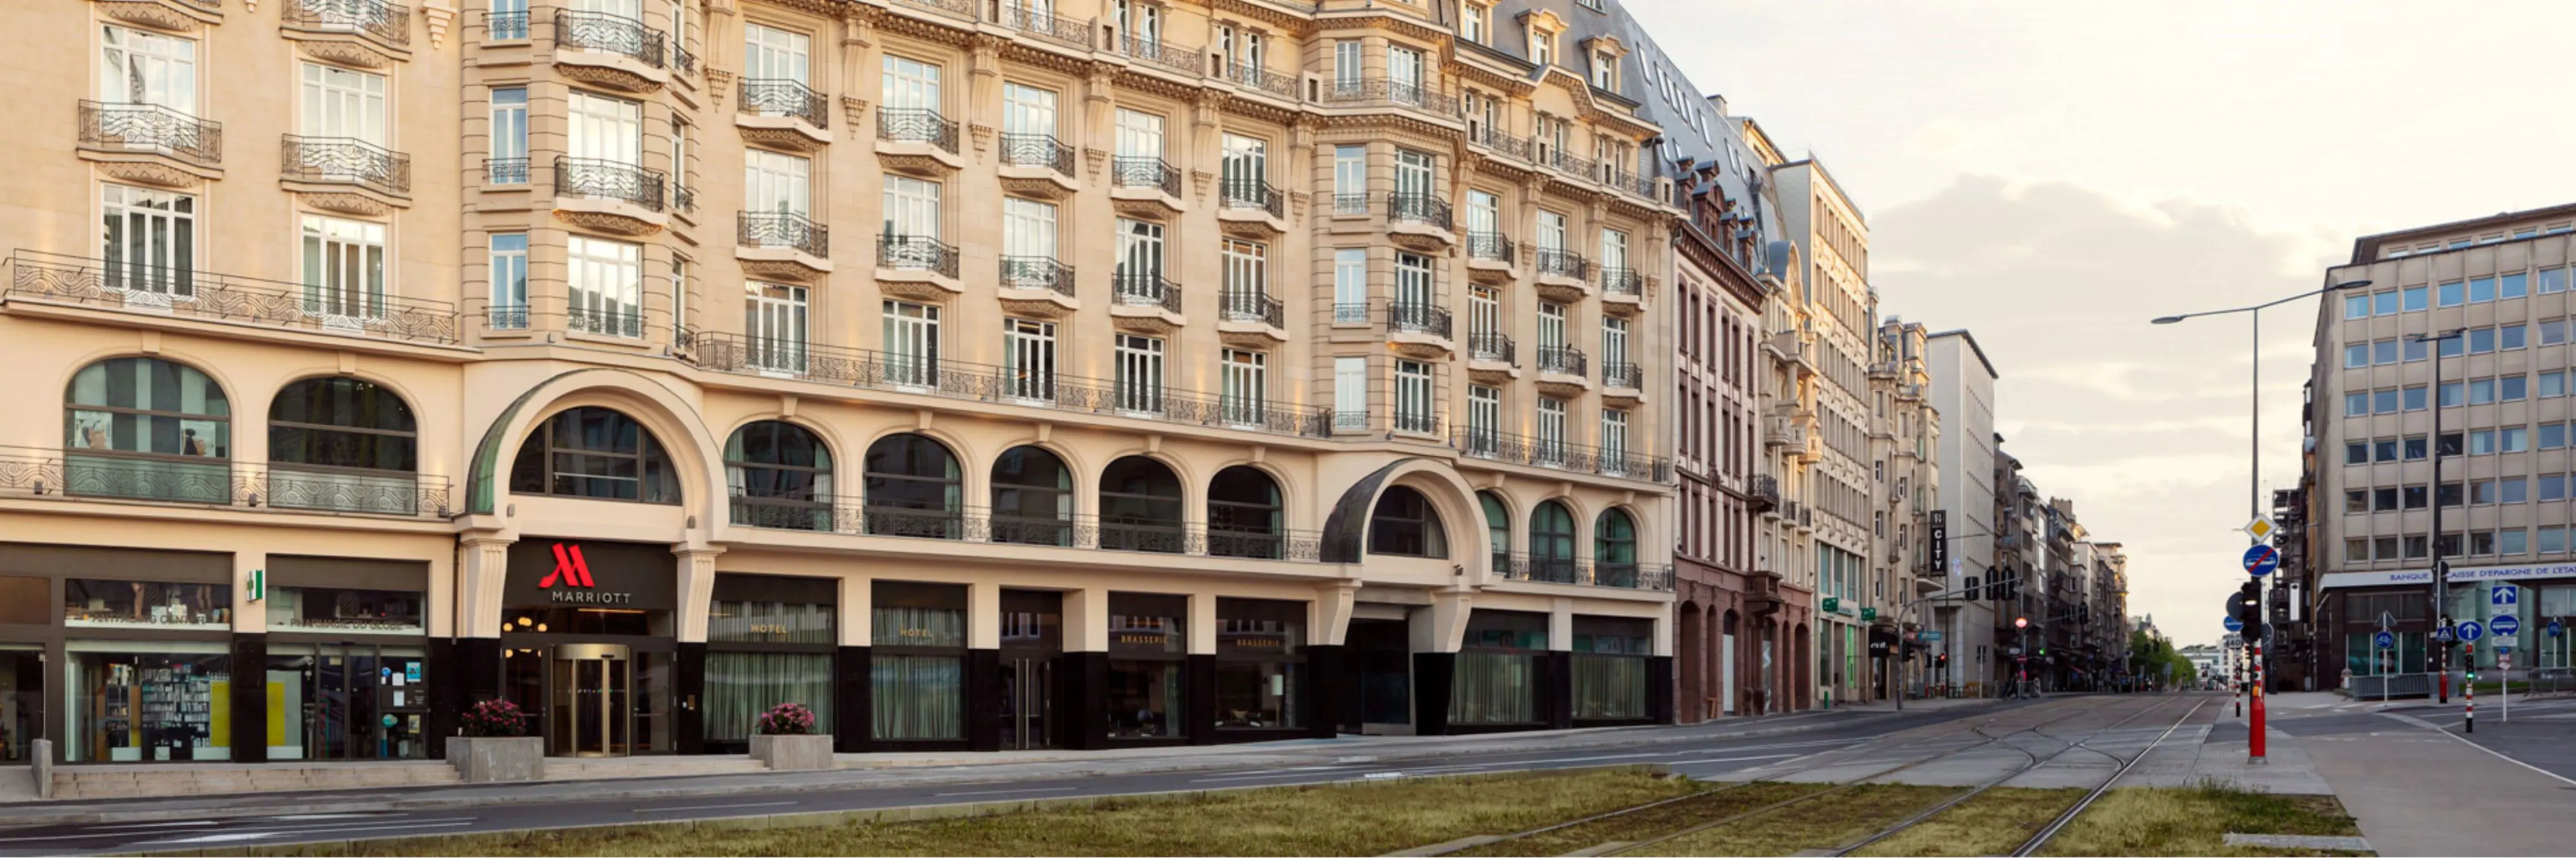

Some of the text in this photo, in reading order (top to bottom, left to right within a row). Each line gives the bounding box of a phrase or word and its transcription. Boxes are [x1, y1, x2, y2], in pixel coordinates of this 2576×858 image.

[1934, 530, 1942, 570] CITY
[552, 590, 630, 604] MARRIOTT
[352, 620, 366, 630] DU
[369, 620, 404, 630] GLOBE
[750, 624, 787, 634] HOTEL
[900, 628, 934, 637] HOTEL
[1121, 635, 1169, 644] BRASSERIE
[1237, 639, 1280, 648] BRASSERIE
